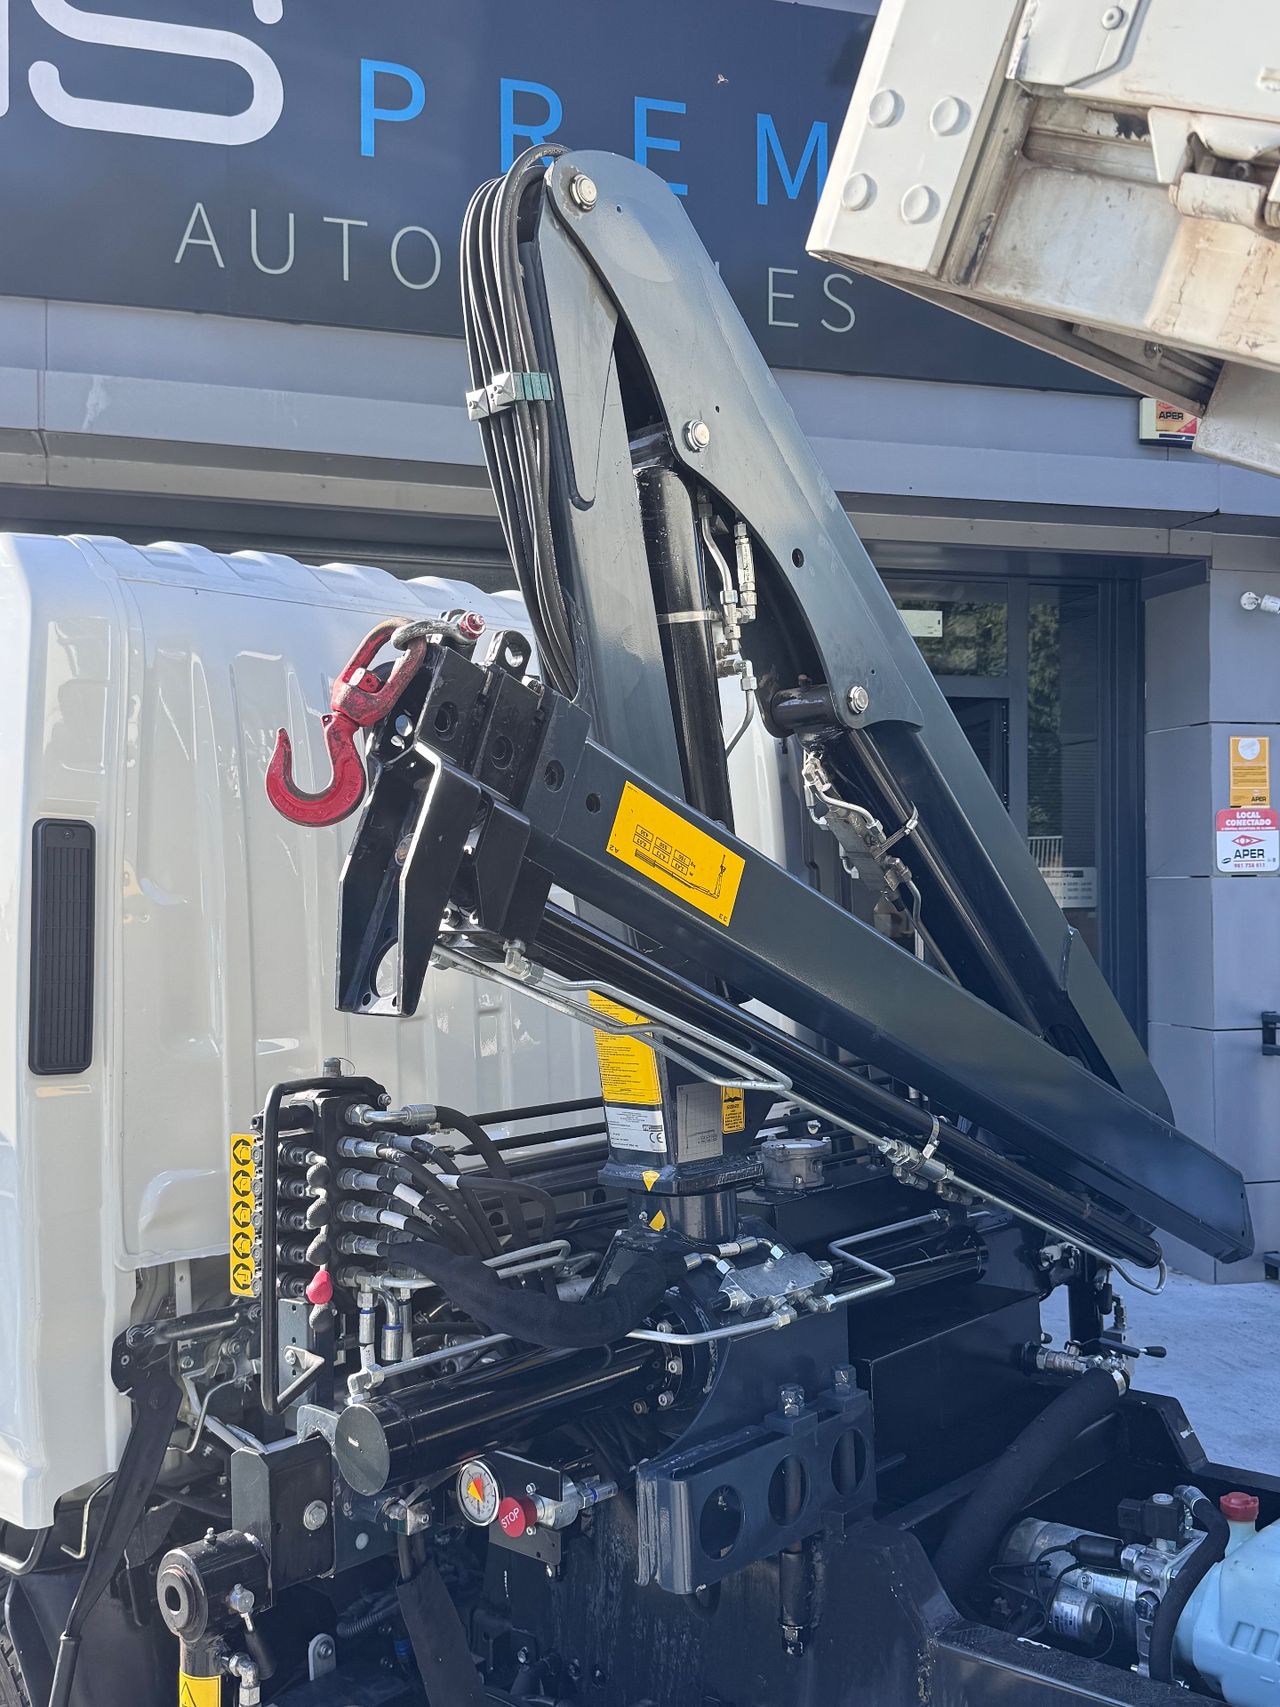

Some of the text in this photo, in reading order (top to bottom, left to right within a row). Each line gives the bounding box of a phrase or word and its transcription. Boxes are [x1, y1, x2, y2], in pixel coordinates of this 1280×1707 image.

[360, 57, 830, 206] PREM
[1159, 411, 1184, 420] APER
[1236, 811, 1261, 819] LOCAL
[1225, 818, 1272, 827] CONECTADO
[1233, 848, 1265, 859] APER
[649, 1132, 664, 1144] CE
[502, 1507, 520, 1529] STOP
